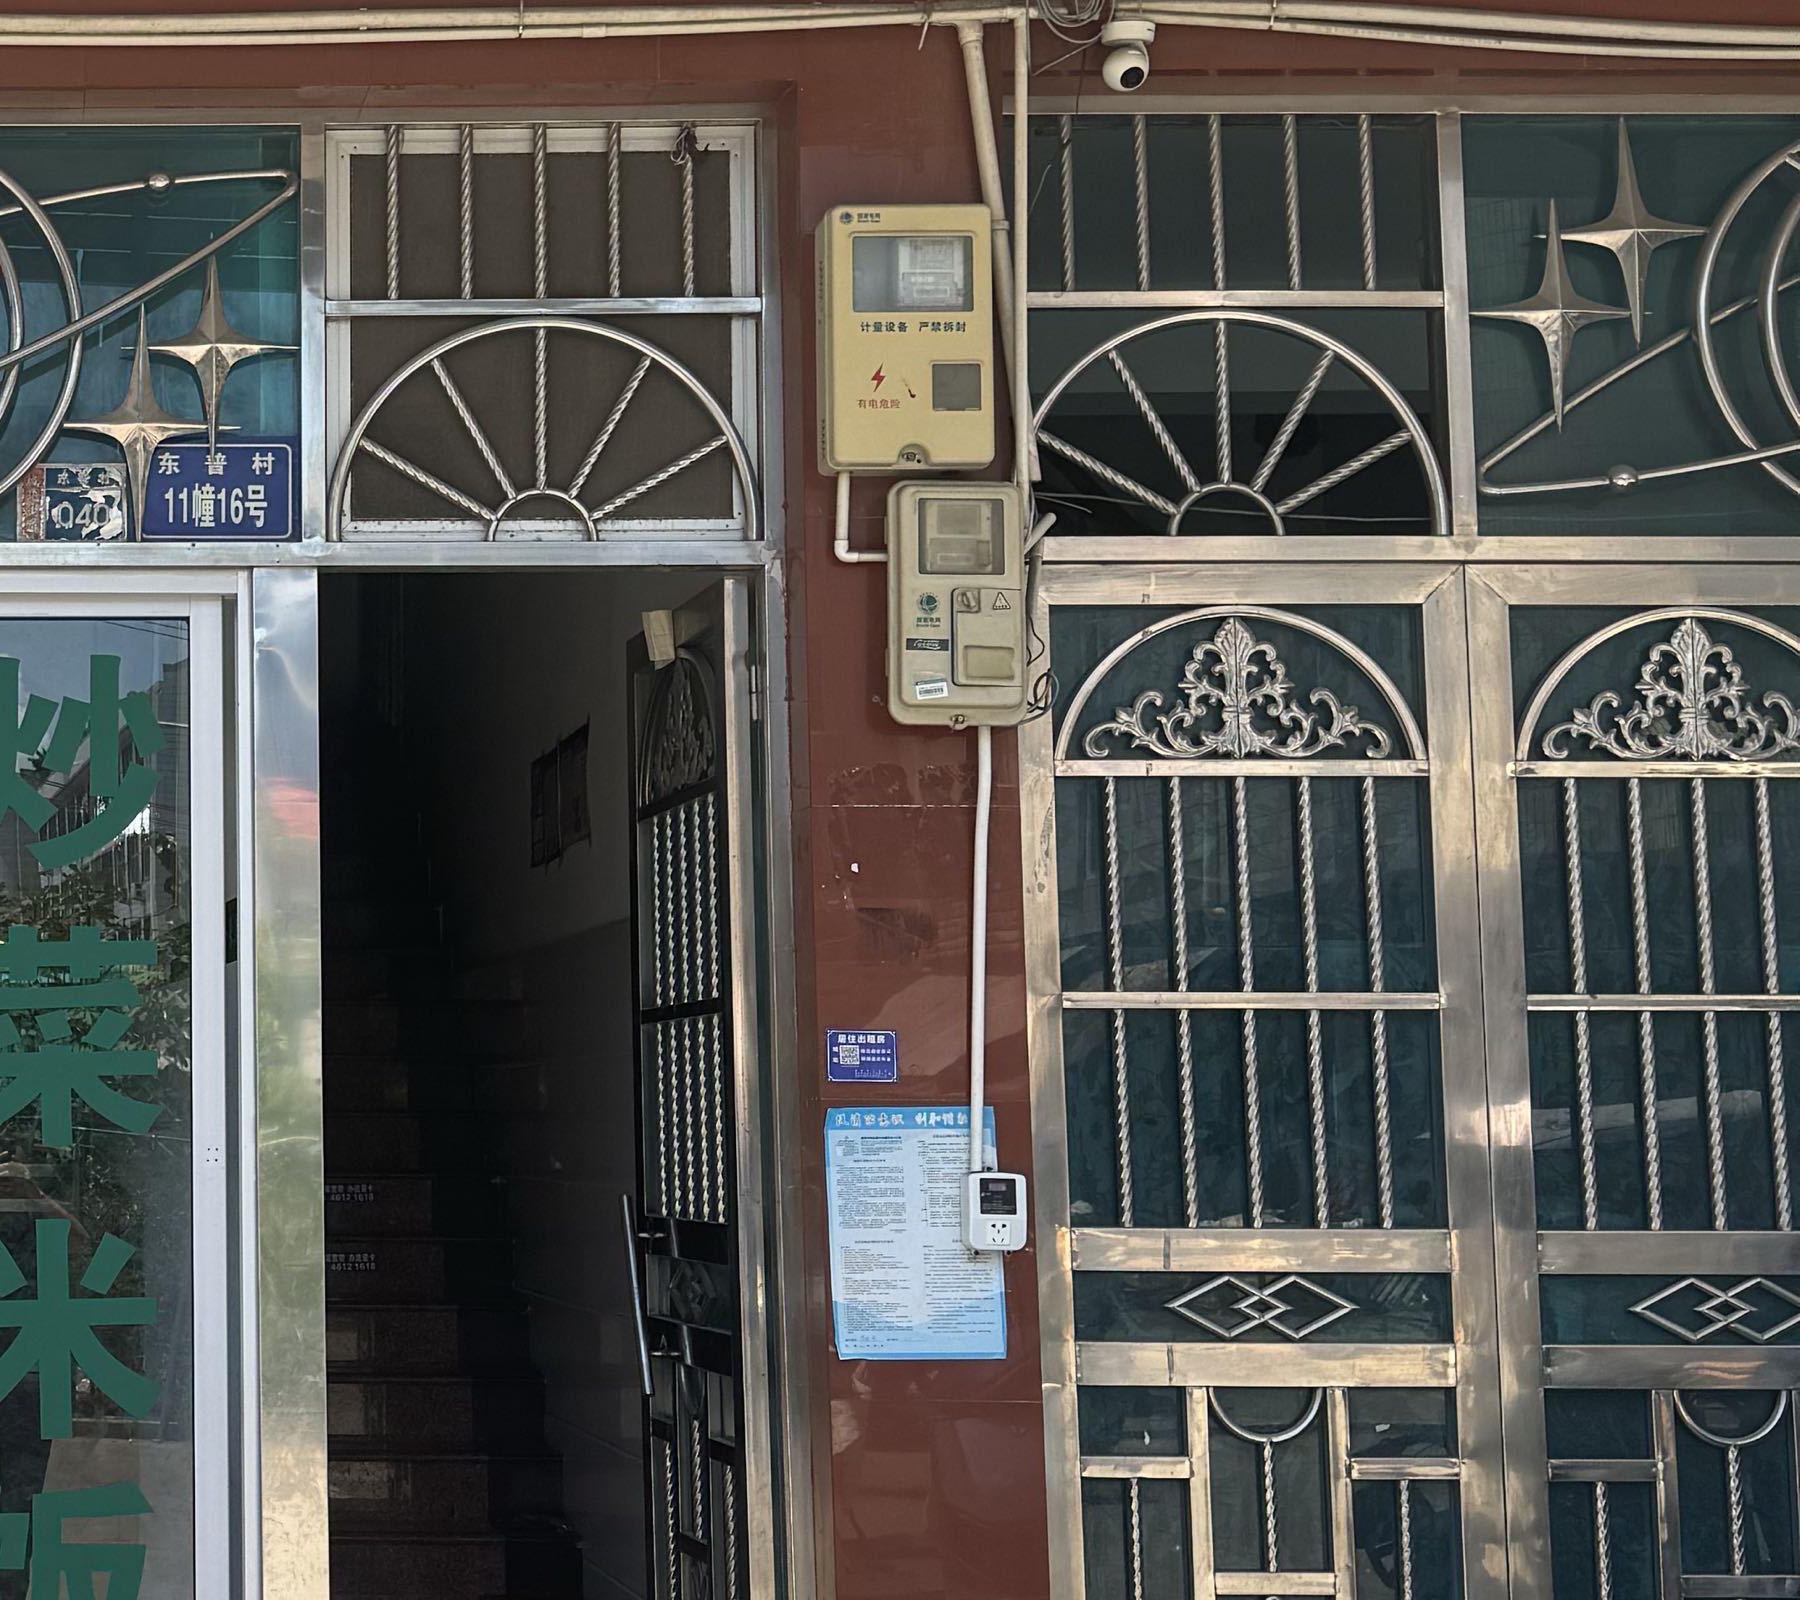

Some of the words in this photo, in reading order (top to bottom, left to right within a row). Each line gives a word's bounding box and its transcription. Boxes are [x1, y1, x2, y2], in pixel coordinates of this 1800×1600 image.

[157, 452, 276, 476] 东普村
[164, 483, 269, 529] 11幢16号
